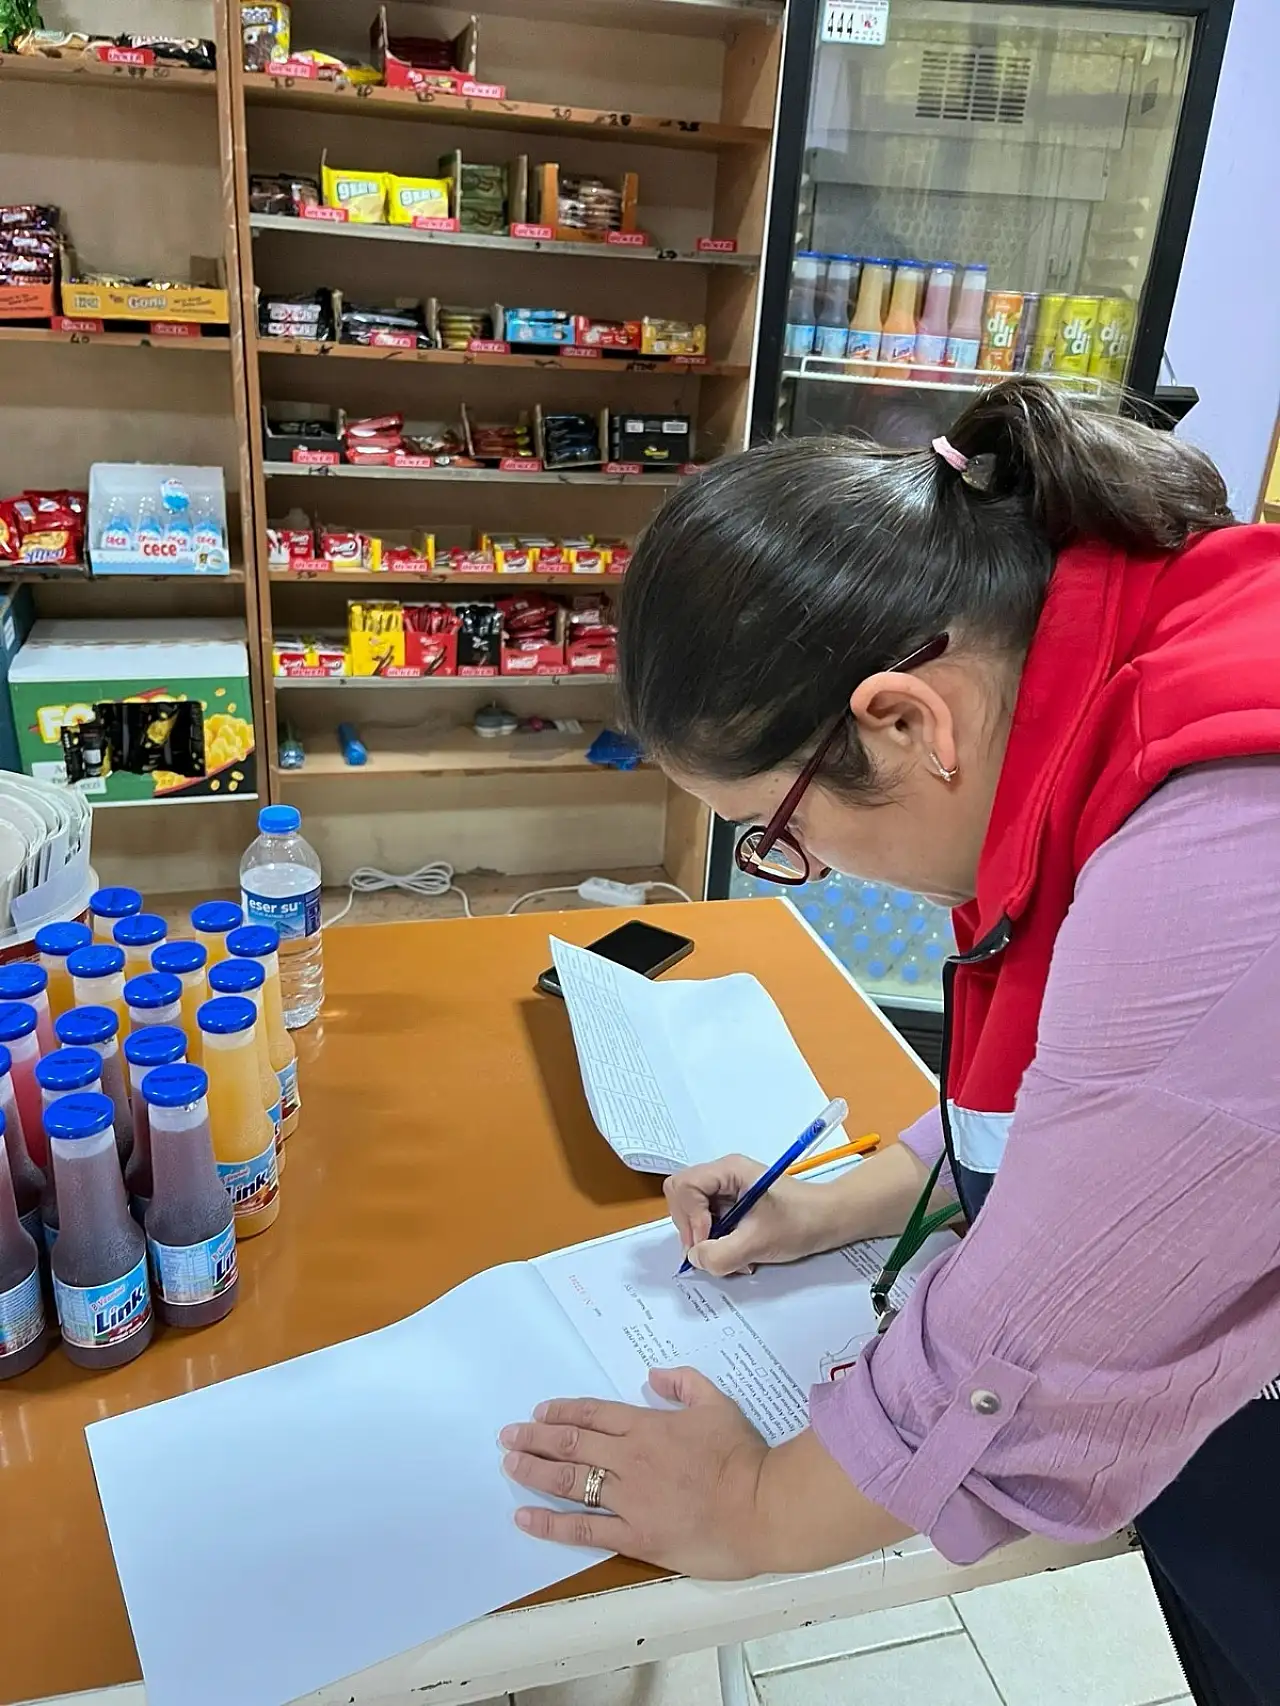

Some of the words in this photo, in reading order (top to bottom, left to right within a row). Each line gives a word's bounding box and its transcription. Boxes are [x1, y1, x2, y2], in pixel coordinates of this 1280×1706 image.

[143, 542, 177, 557] cece
[249, 899, 278, 914] eser
[281, 902, 299, 914] su
[95, 1281, 145, 1336] Link
